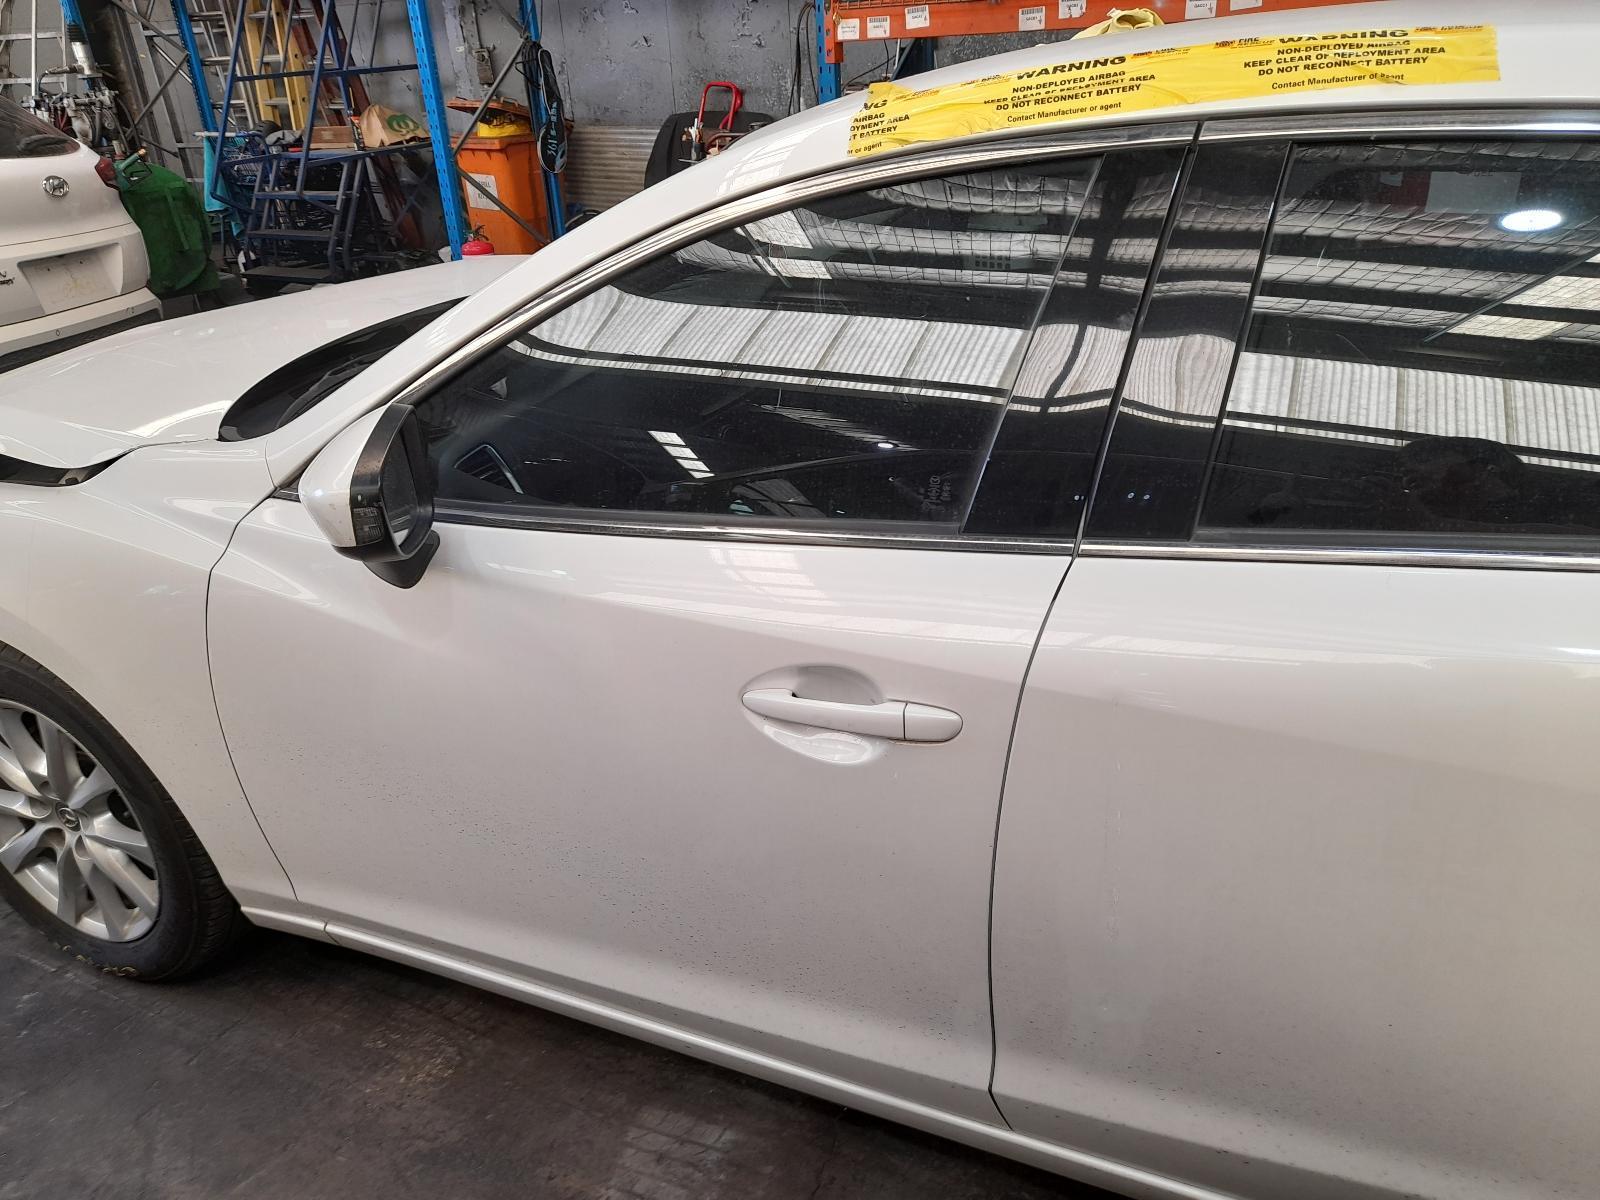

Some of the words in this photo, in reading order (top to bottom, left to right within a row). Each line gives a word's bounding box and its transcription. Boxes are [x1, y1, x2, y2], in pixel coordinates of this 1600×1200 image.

[1243, 59, 1272, 69] KEEP
[1276, 55, 1312, 64] CLEAR
[1414, 46, 1446, 54] AREA
[1277, 42, 1364, 55] NON-DEPLOYED
[1016, 56, 1127, 80] WARNING
[1258, 68, 1274, 76] DO
[1277, 65, 1300, 74] NOT
[1303, 59, 1372, 71] RECONNECT
[1375, 56, 1429, 66] BATTERY
[983, 97, 1008, 105] KEEP
[1010, 92, 1041, 102] CLEAR
[1128, 74, 1156, 82] AREA
[1012, 76, 1086, 93] NON-DEPLOYED
[1088, 70, 1126, 82] AIRBAG
[1271, 79, 1305, 90] Contact
[1307, 74, 1367, 85] Manufacturer
[995, 103, 1009, 111] DO
[1011, 99, 1032, 110] NOT
[1034, 90, 1093, 106] RECONNECT
[1096, 83, 1141, 97] BATTERY
[853, 112, 885, 123] AIRBAG
[886, 114, 910, 125] AREA
[1007, 113, 1036, 123] Contact
[1037, 106, 1087, 119] Manufacturer
[1099, 102, 1122, 111] agent
[859, 125, 898, 139] BATTERY
[863, 141, 882, 152] agent
